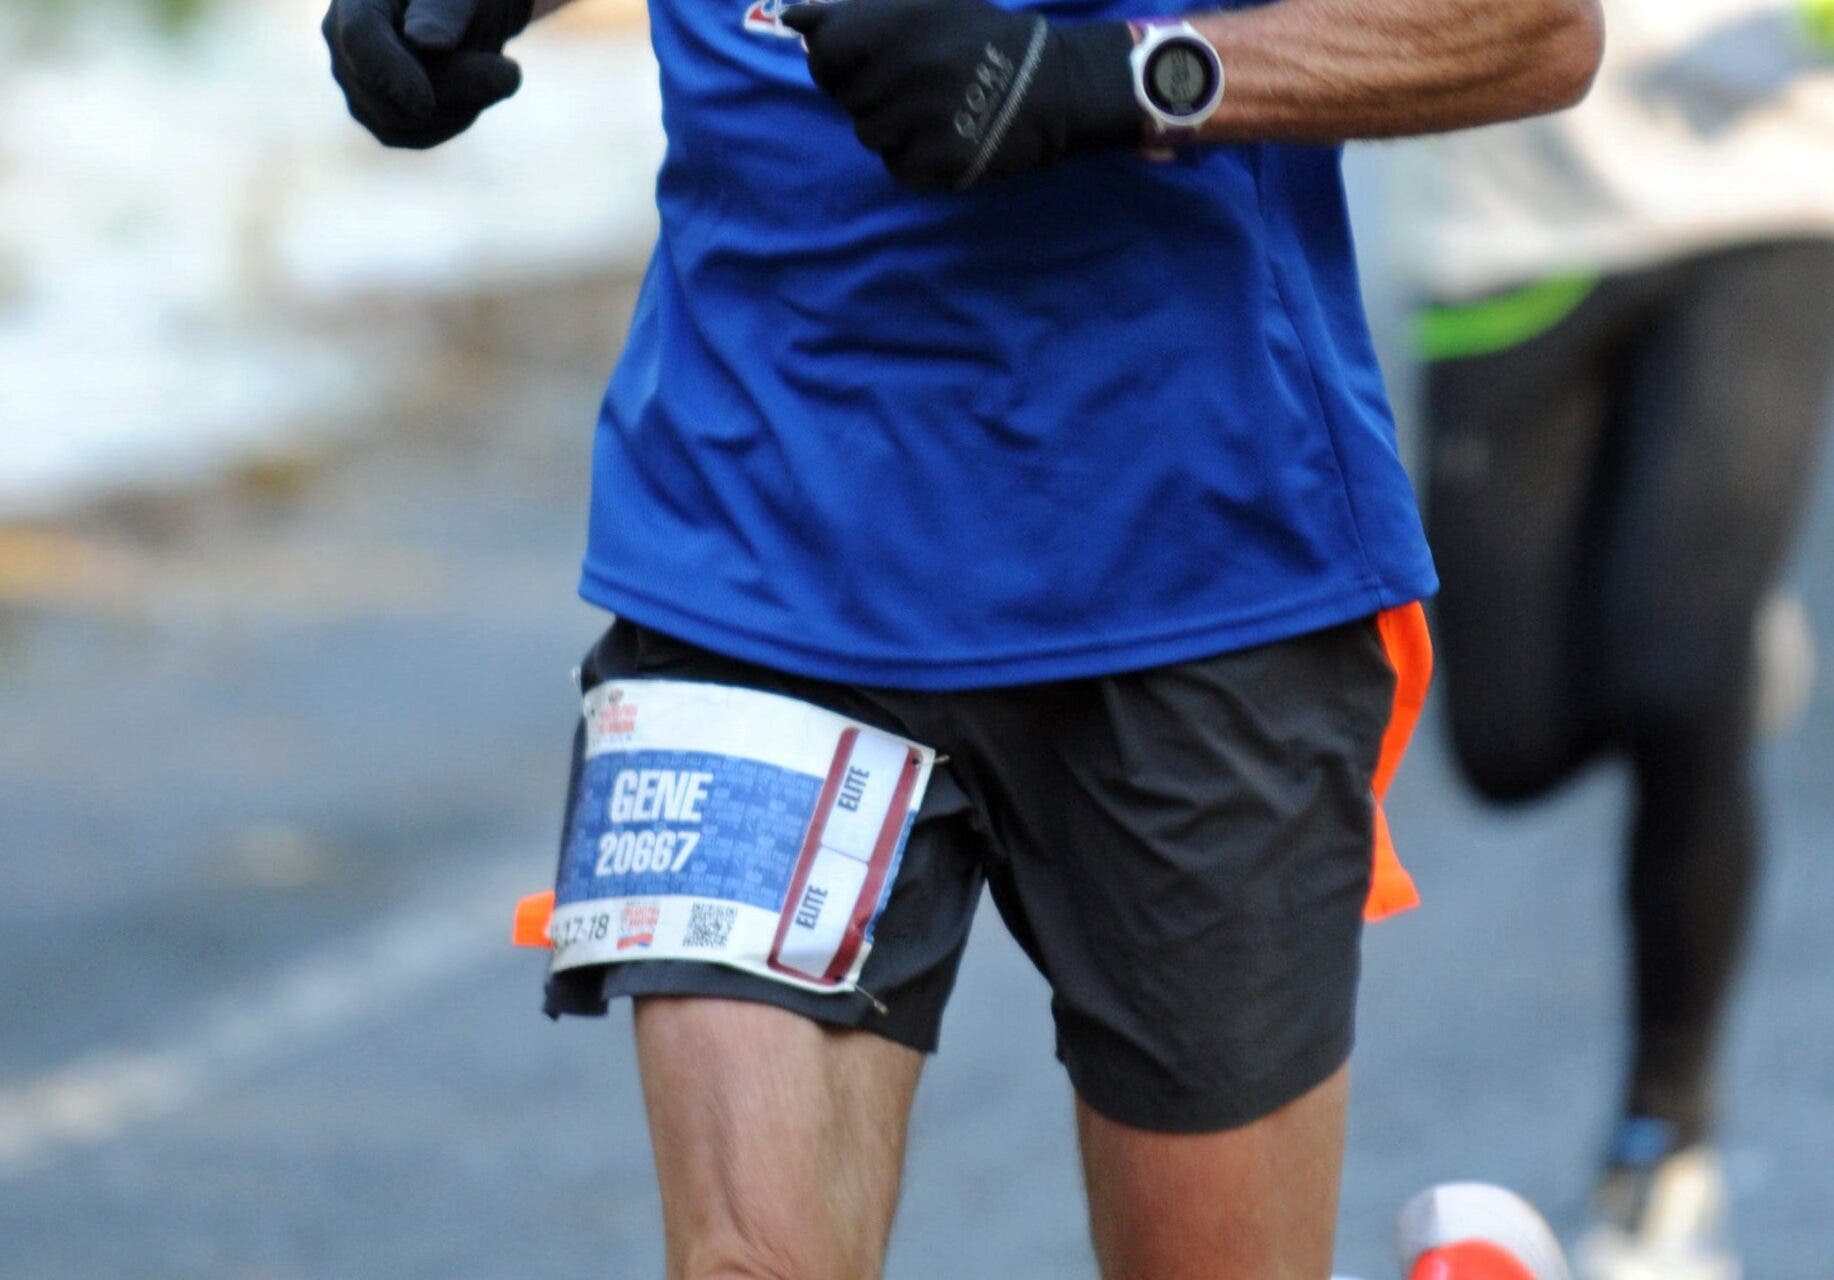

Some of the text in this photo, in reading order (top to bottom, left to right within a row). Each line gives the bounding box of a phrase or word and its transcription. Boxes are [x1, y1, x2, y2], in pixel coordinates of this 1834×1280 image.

[610, 768, 713, 823] GENE
[837, 765, 870, 813] ELITE
[595, 830, 701, 879] 20667
[796, 884, 829, 931] ELITE
